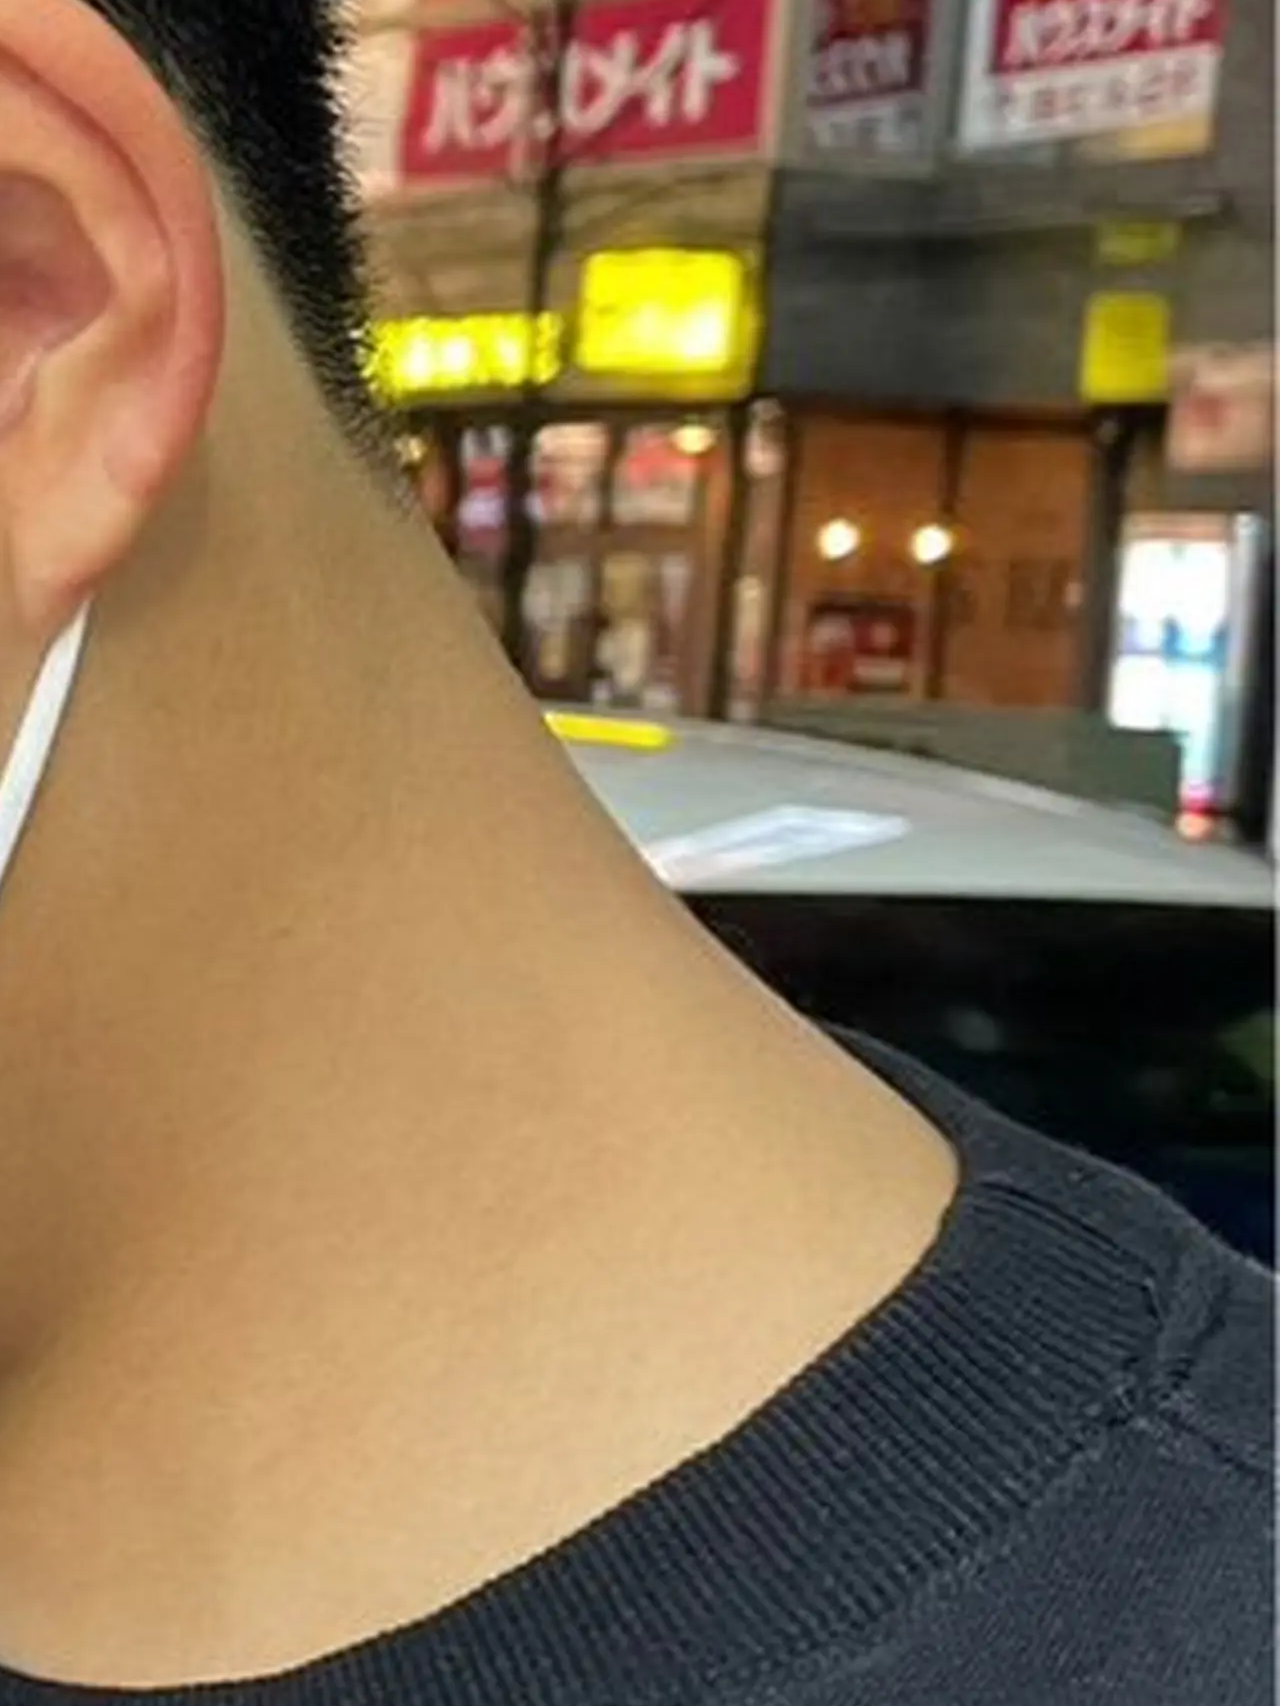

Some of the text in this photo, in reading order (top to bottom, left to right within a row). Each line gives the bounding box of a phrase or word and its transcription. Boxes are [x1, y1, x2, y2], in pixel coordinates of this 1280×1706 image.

[417, 15, 739, 153] ハウメイト
